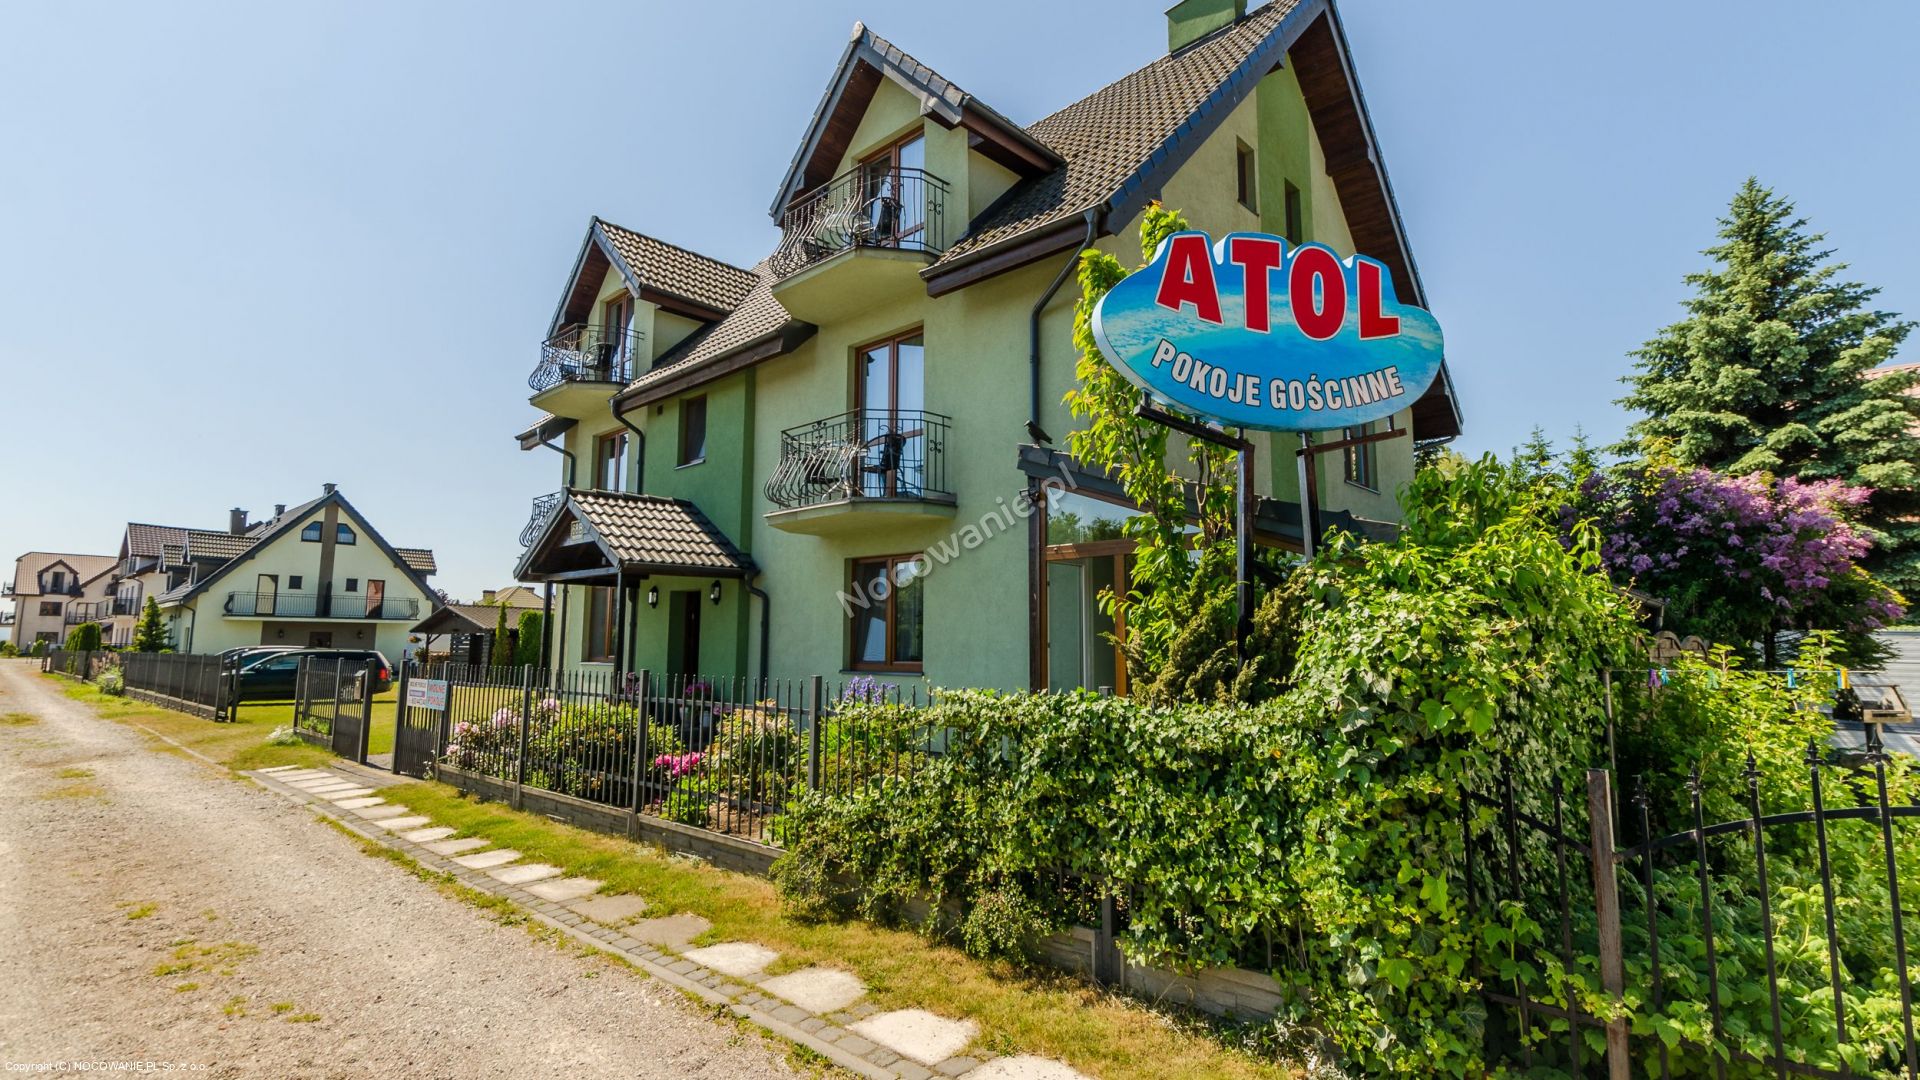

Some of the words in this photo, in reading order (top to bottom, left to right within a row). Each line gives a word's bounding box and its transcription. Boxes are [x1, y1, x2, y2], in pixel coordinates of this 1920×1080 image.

[1155, 234, 1401, 341] ATOL
[1151, 339, 1261, 407] POKOJE
[1269, 365, 1405, 411] GOŚCINNE
